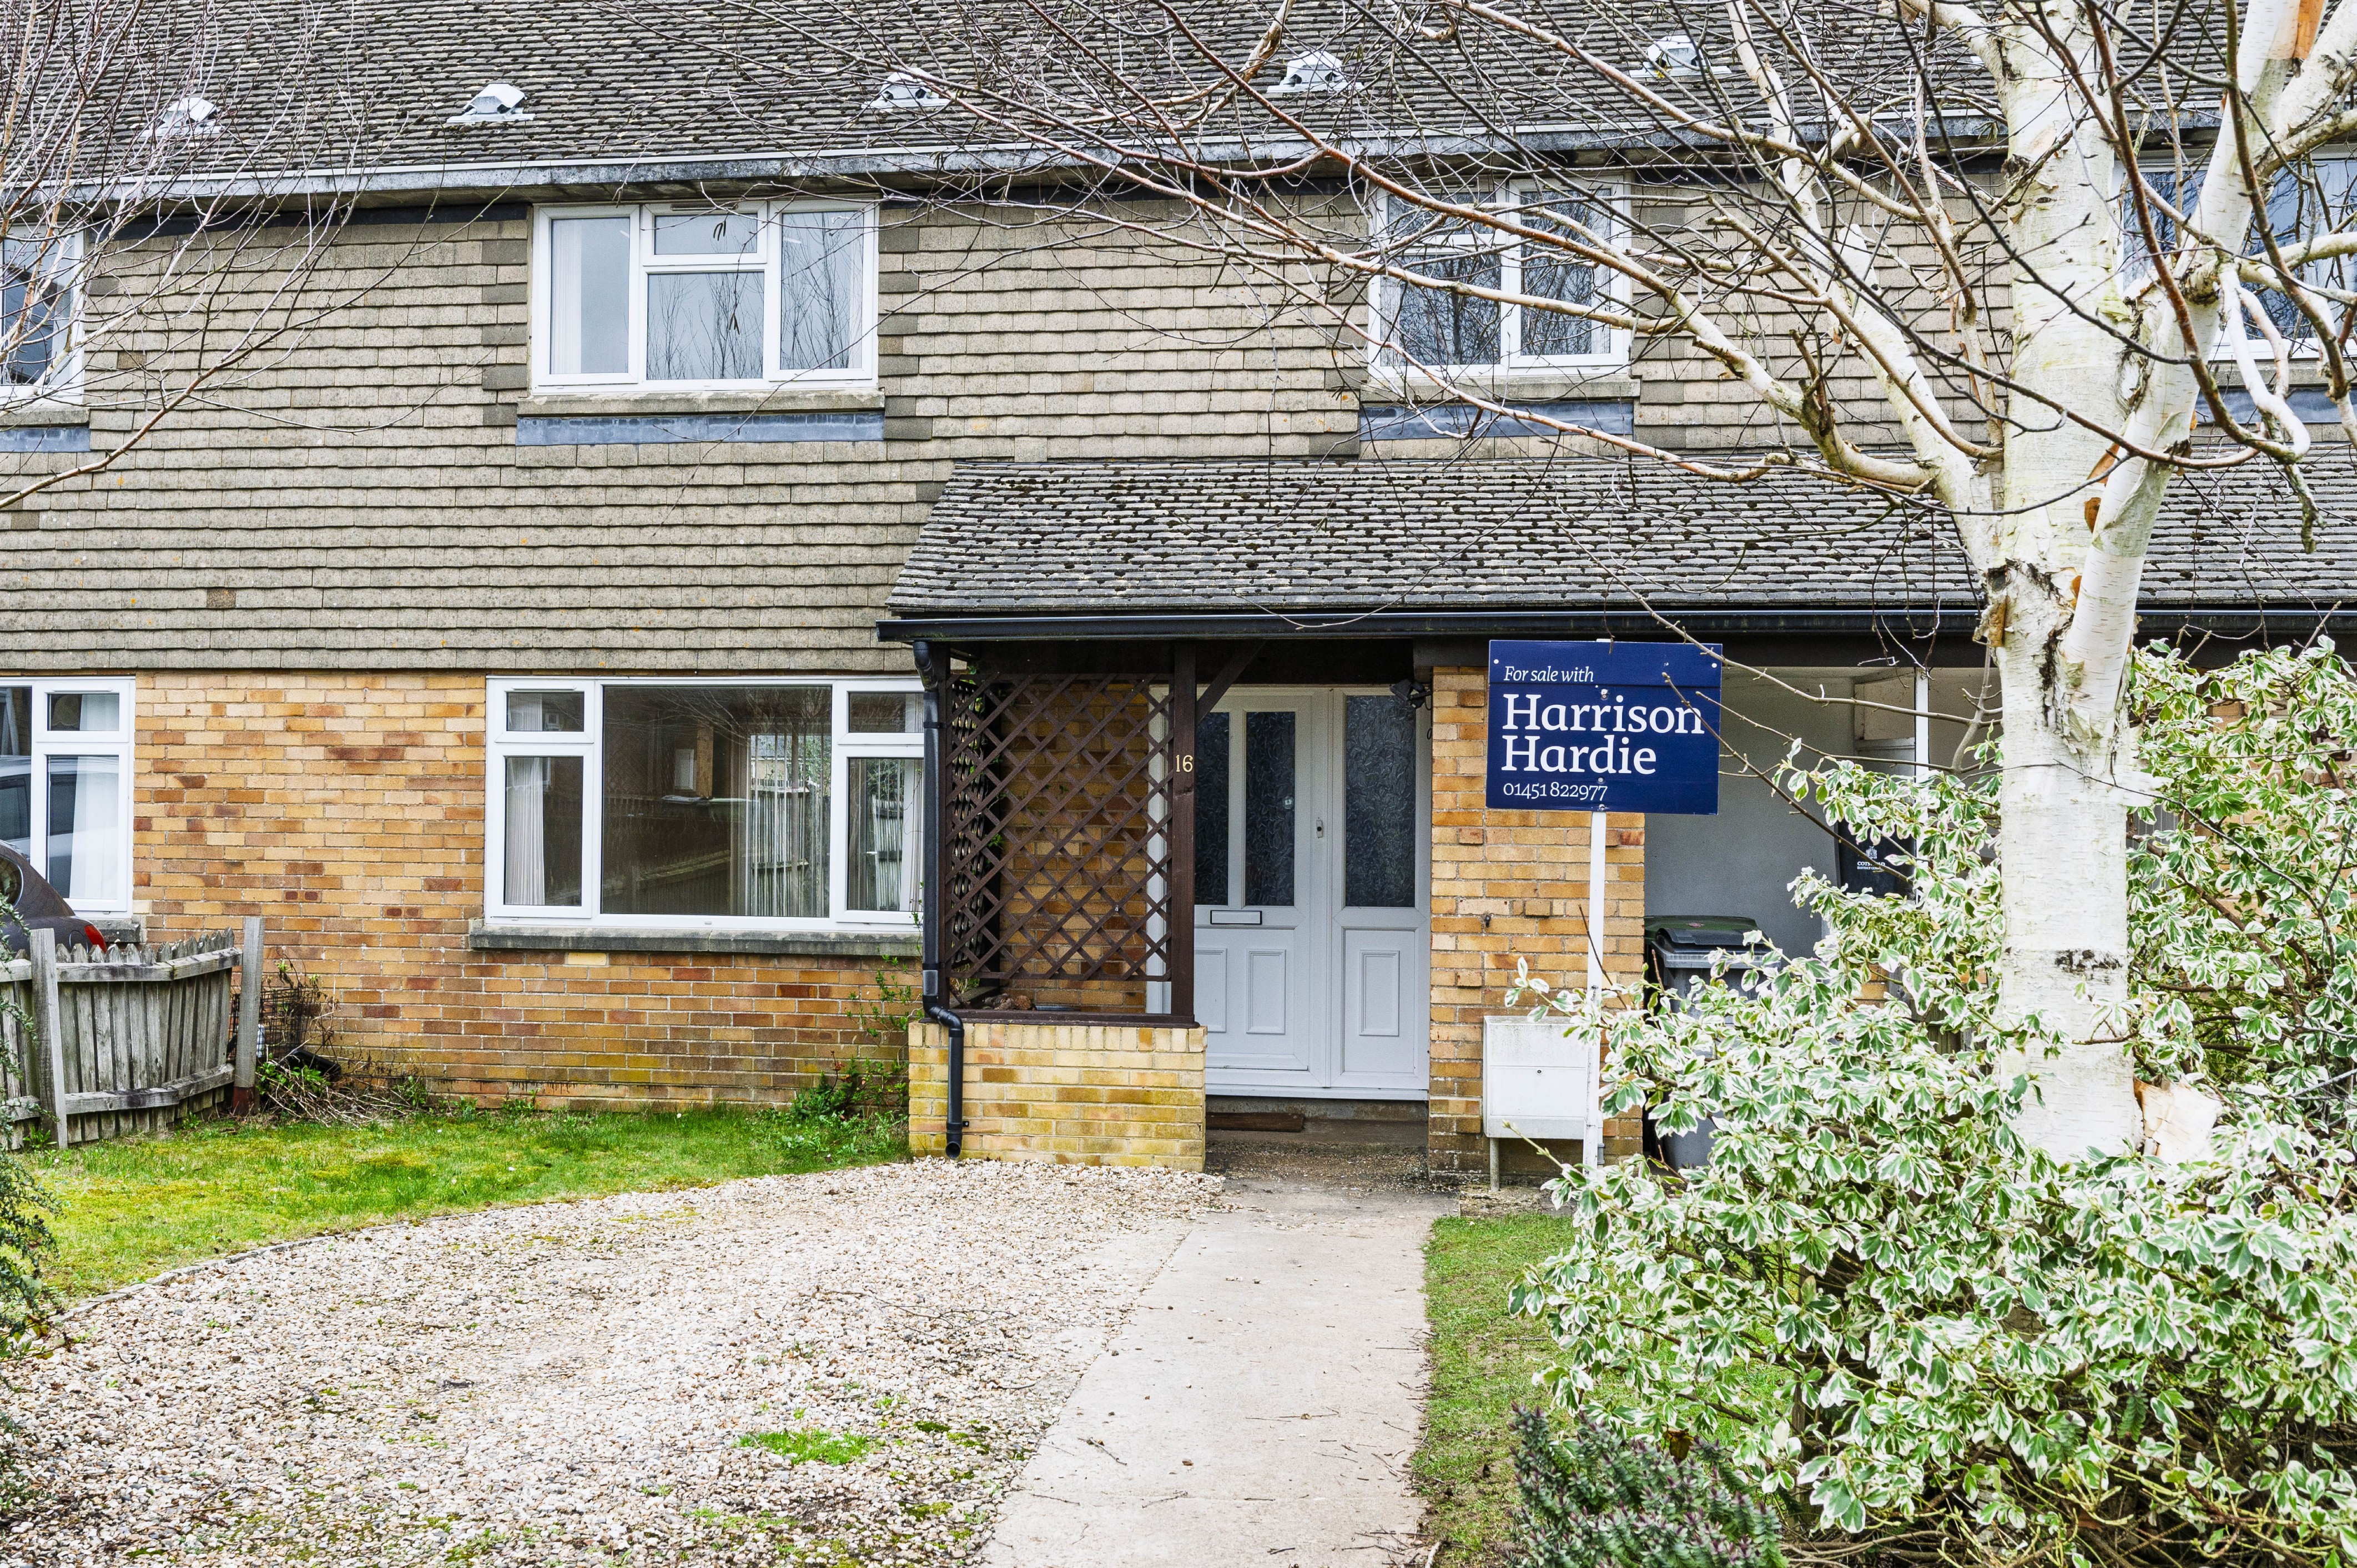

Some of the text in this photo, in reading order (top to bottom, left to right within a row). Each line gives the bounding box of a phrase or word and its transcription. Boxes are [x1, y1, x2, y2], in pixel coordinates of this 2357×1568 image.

[1503, 665, 1594, 682] For sale with
[1502, 693, 1705, 734] Harrison
[1175, 754, 1193, 773] 16
[1501, 734, 1656, 774] Hardie
[1503, 782, 1608, 801] 01451 822977
